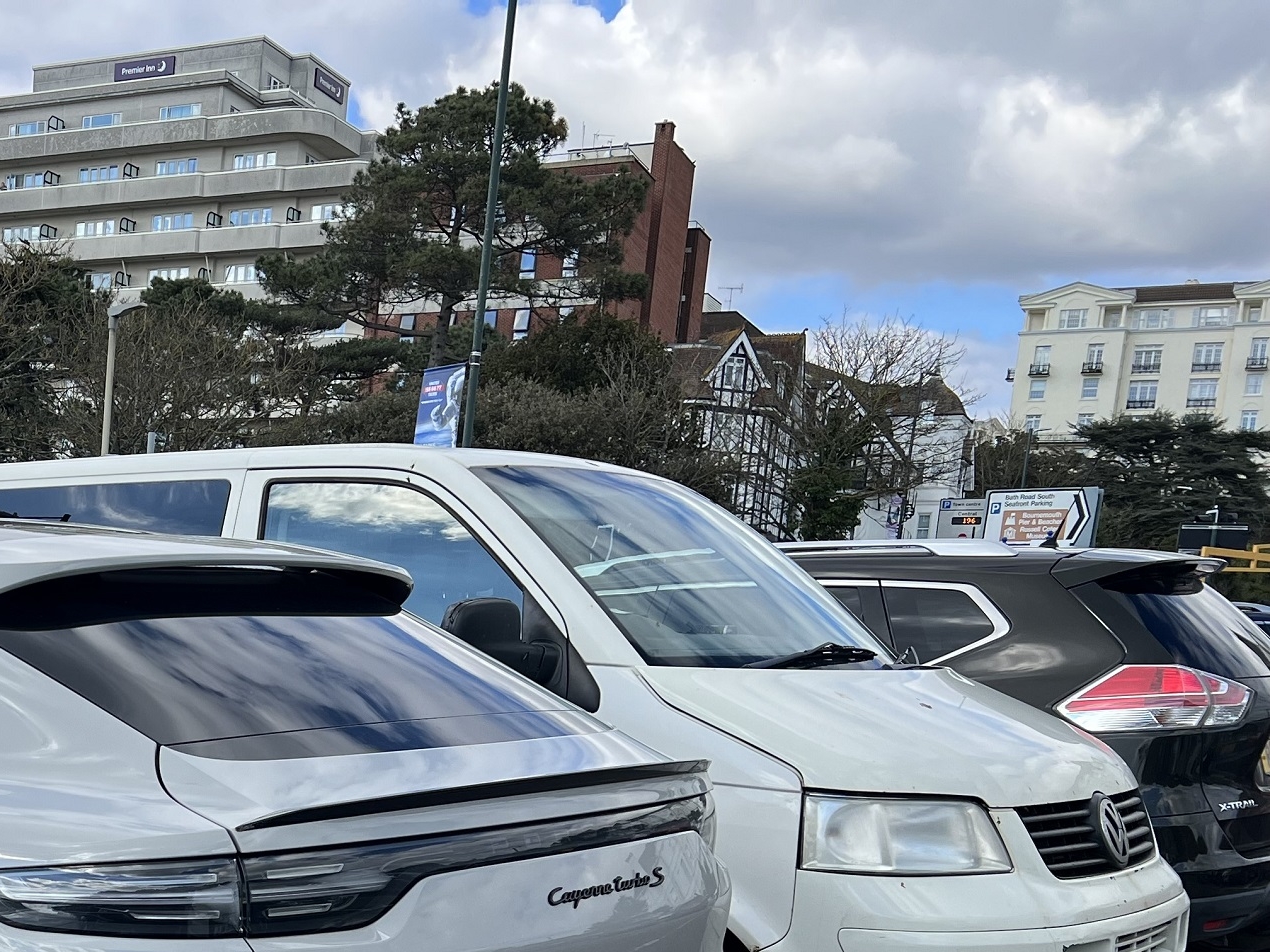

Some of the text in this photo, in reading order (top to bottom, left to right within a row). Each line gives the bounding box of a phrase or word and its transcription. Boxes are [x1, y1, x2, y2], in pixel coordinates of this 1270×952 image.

[121, 66, 145, 75] Premier
[1219, 799, 1259, 812] X-TRAIL
[548, 887, 614, 909] Cayenne
[649, 867, 665, 887] S
